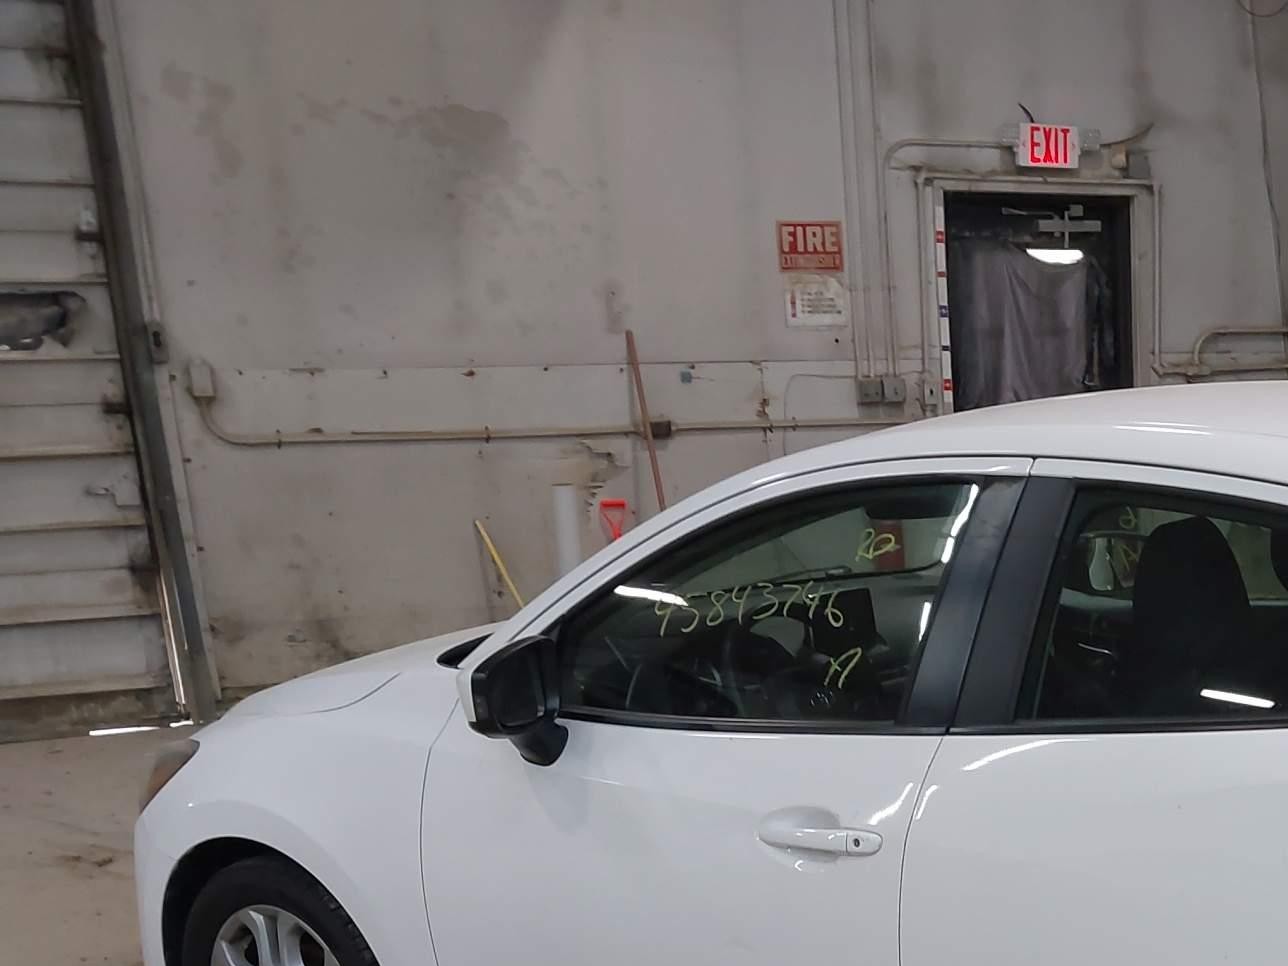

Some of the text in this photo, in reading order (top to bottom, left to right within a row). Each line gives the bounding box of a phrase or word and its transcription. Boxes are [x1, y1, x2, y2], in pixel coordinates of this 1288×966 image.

[1030, 126, 1070, 164] EXIT
[781, 225, 839, 253] FIRE
[654, 580, 844, 638] 45843746
